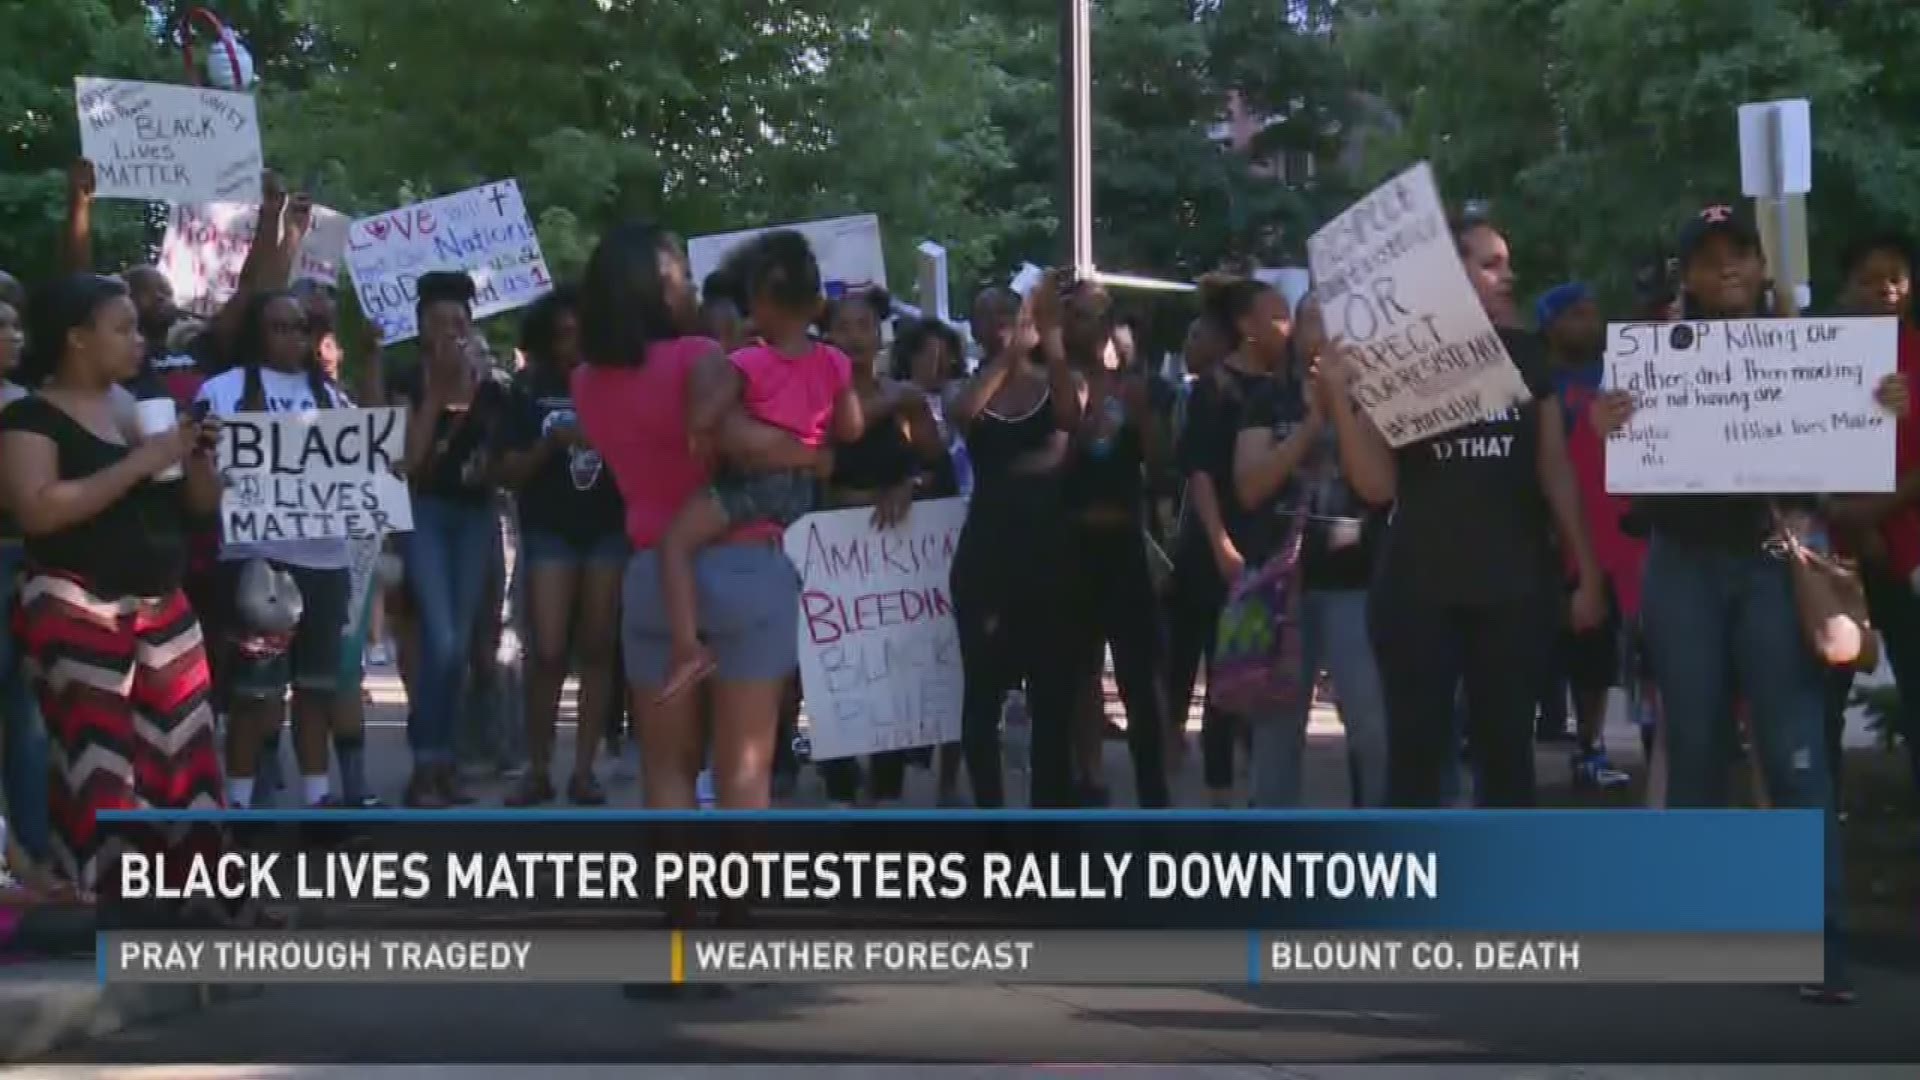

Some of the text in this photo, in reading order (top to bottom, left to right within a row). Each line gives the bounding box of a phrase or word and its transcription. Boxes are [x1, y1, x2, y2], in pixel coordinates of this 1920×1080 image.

[136, 114, 216, 139] BLACK
[97, 160, 191, 187] MATTER
[1344, 275, 1411, 342] OR
[1616, 322, 1710, 355] STOP
[221, 409, 404, 481] BLACK
[1456, 436, 1514, 457] THAT
[274, 478, 380, 512] LIVES
[229, 509, 397, 542] MATTER
